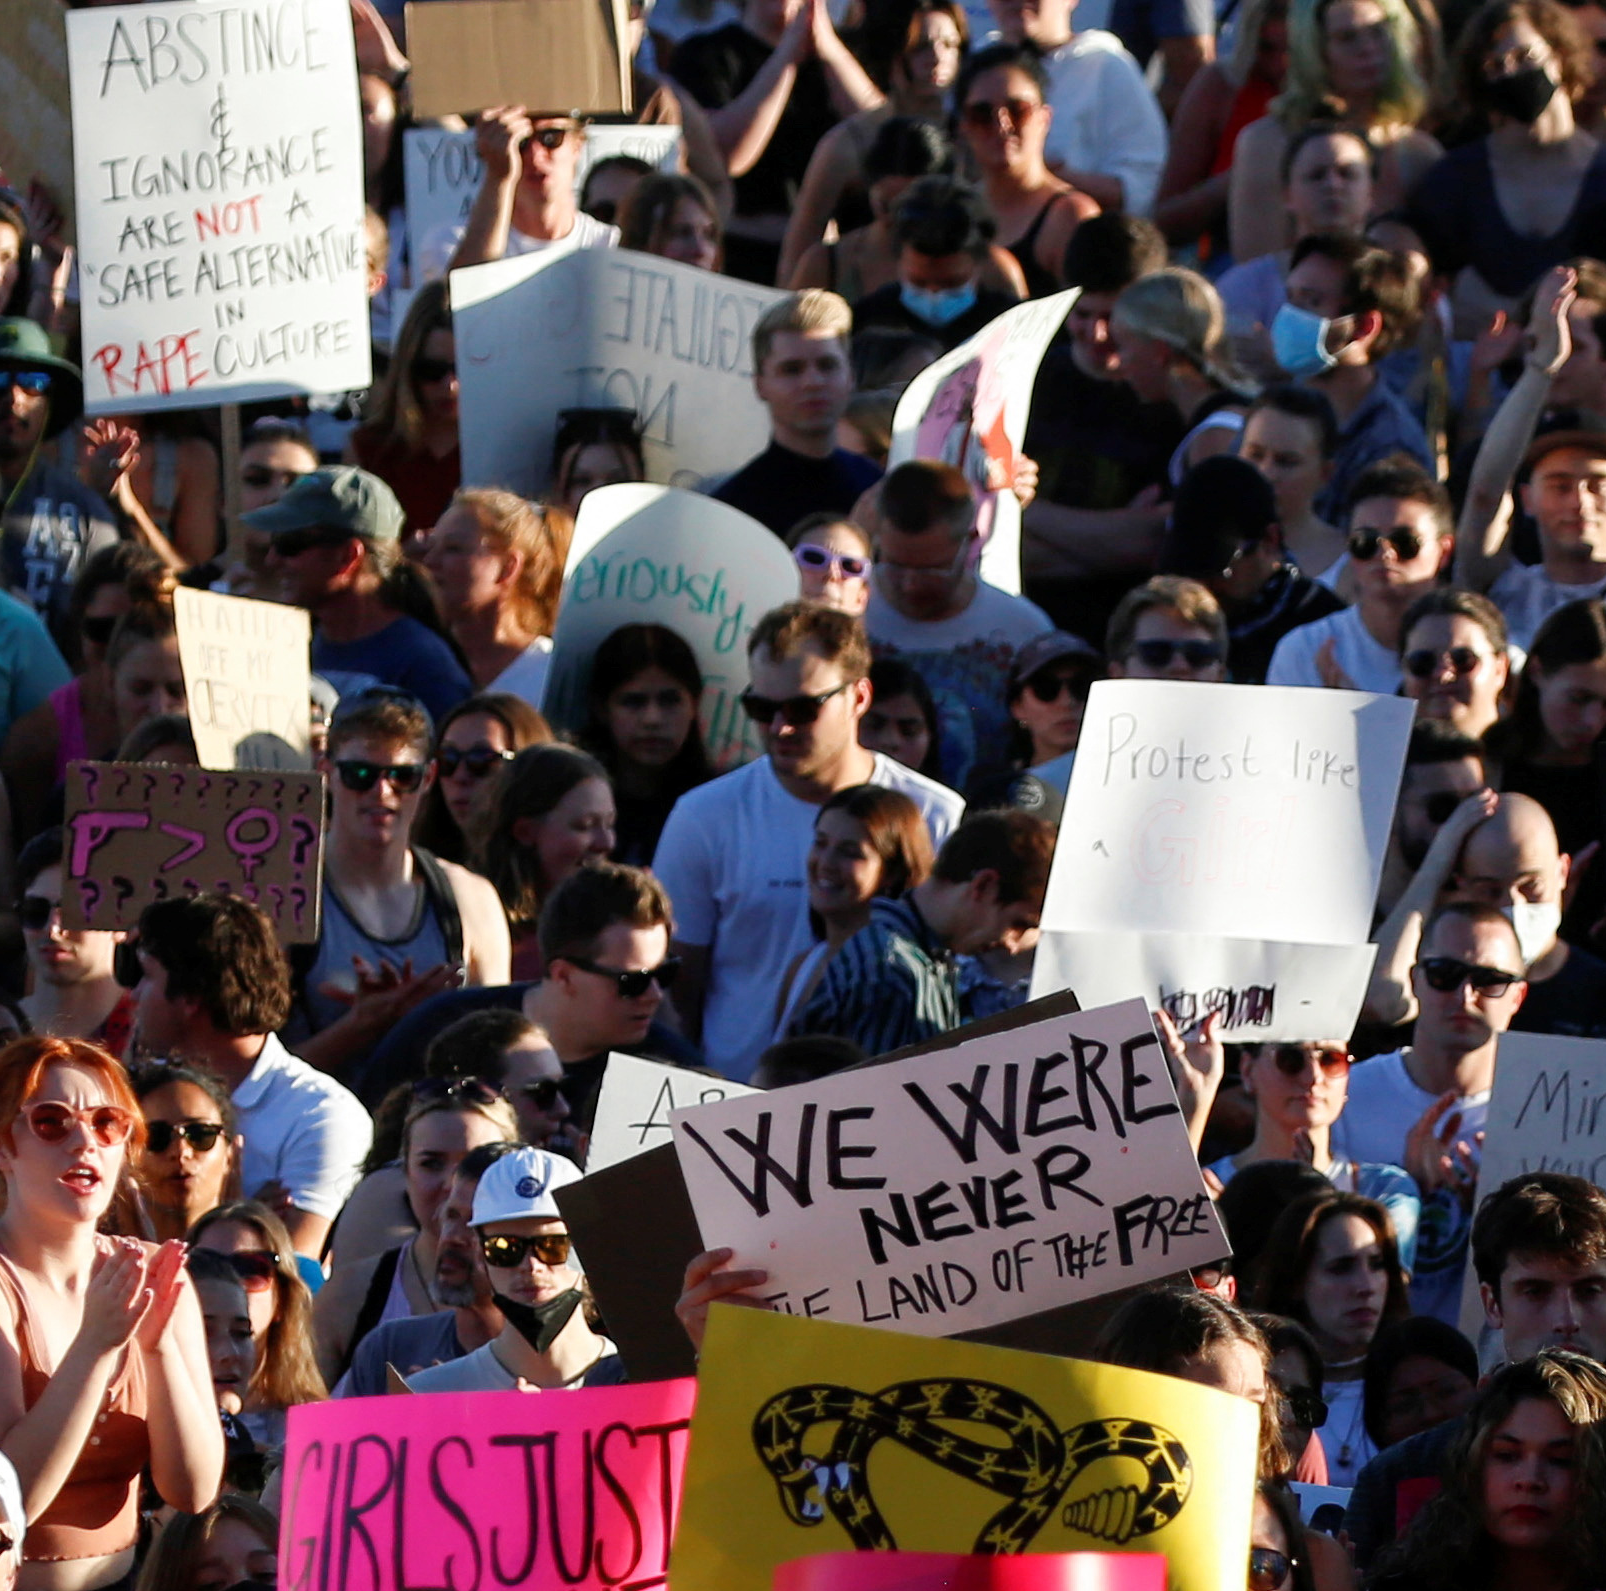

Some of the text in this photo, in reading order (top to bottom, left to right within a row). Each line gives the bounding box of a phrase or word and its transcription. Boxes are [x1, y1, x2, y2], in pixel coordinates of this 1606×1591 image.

[100, 8, 329, 98] ABSTINCE
[101, 127, 335, 203] IGNORANCE
[117, 191, 311, 253] ARE NOT A
[93, 320, 353, 395] RAPE CULTURE
[215, 298, 245, 330] IN
[1103, 712, 1358, 787] Protest like
[1128, 795, 1298, 890] Girl
[682, 1104, 888, 1217] WE
[903, 1033, 1180, 1165] WERE
[860, 1144, 1104, 1266] NEVER
[860, 1191, 1211, 1323] LAND OF THE FREE
[490, 1418, 690, 1587] JUST
